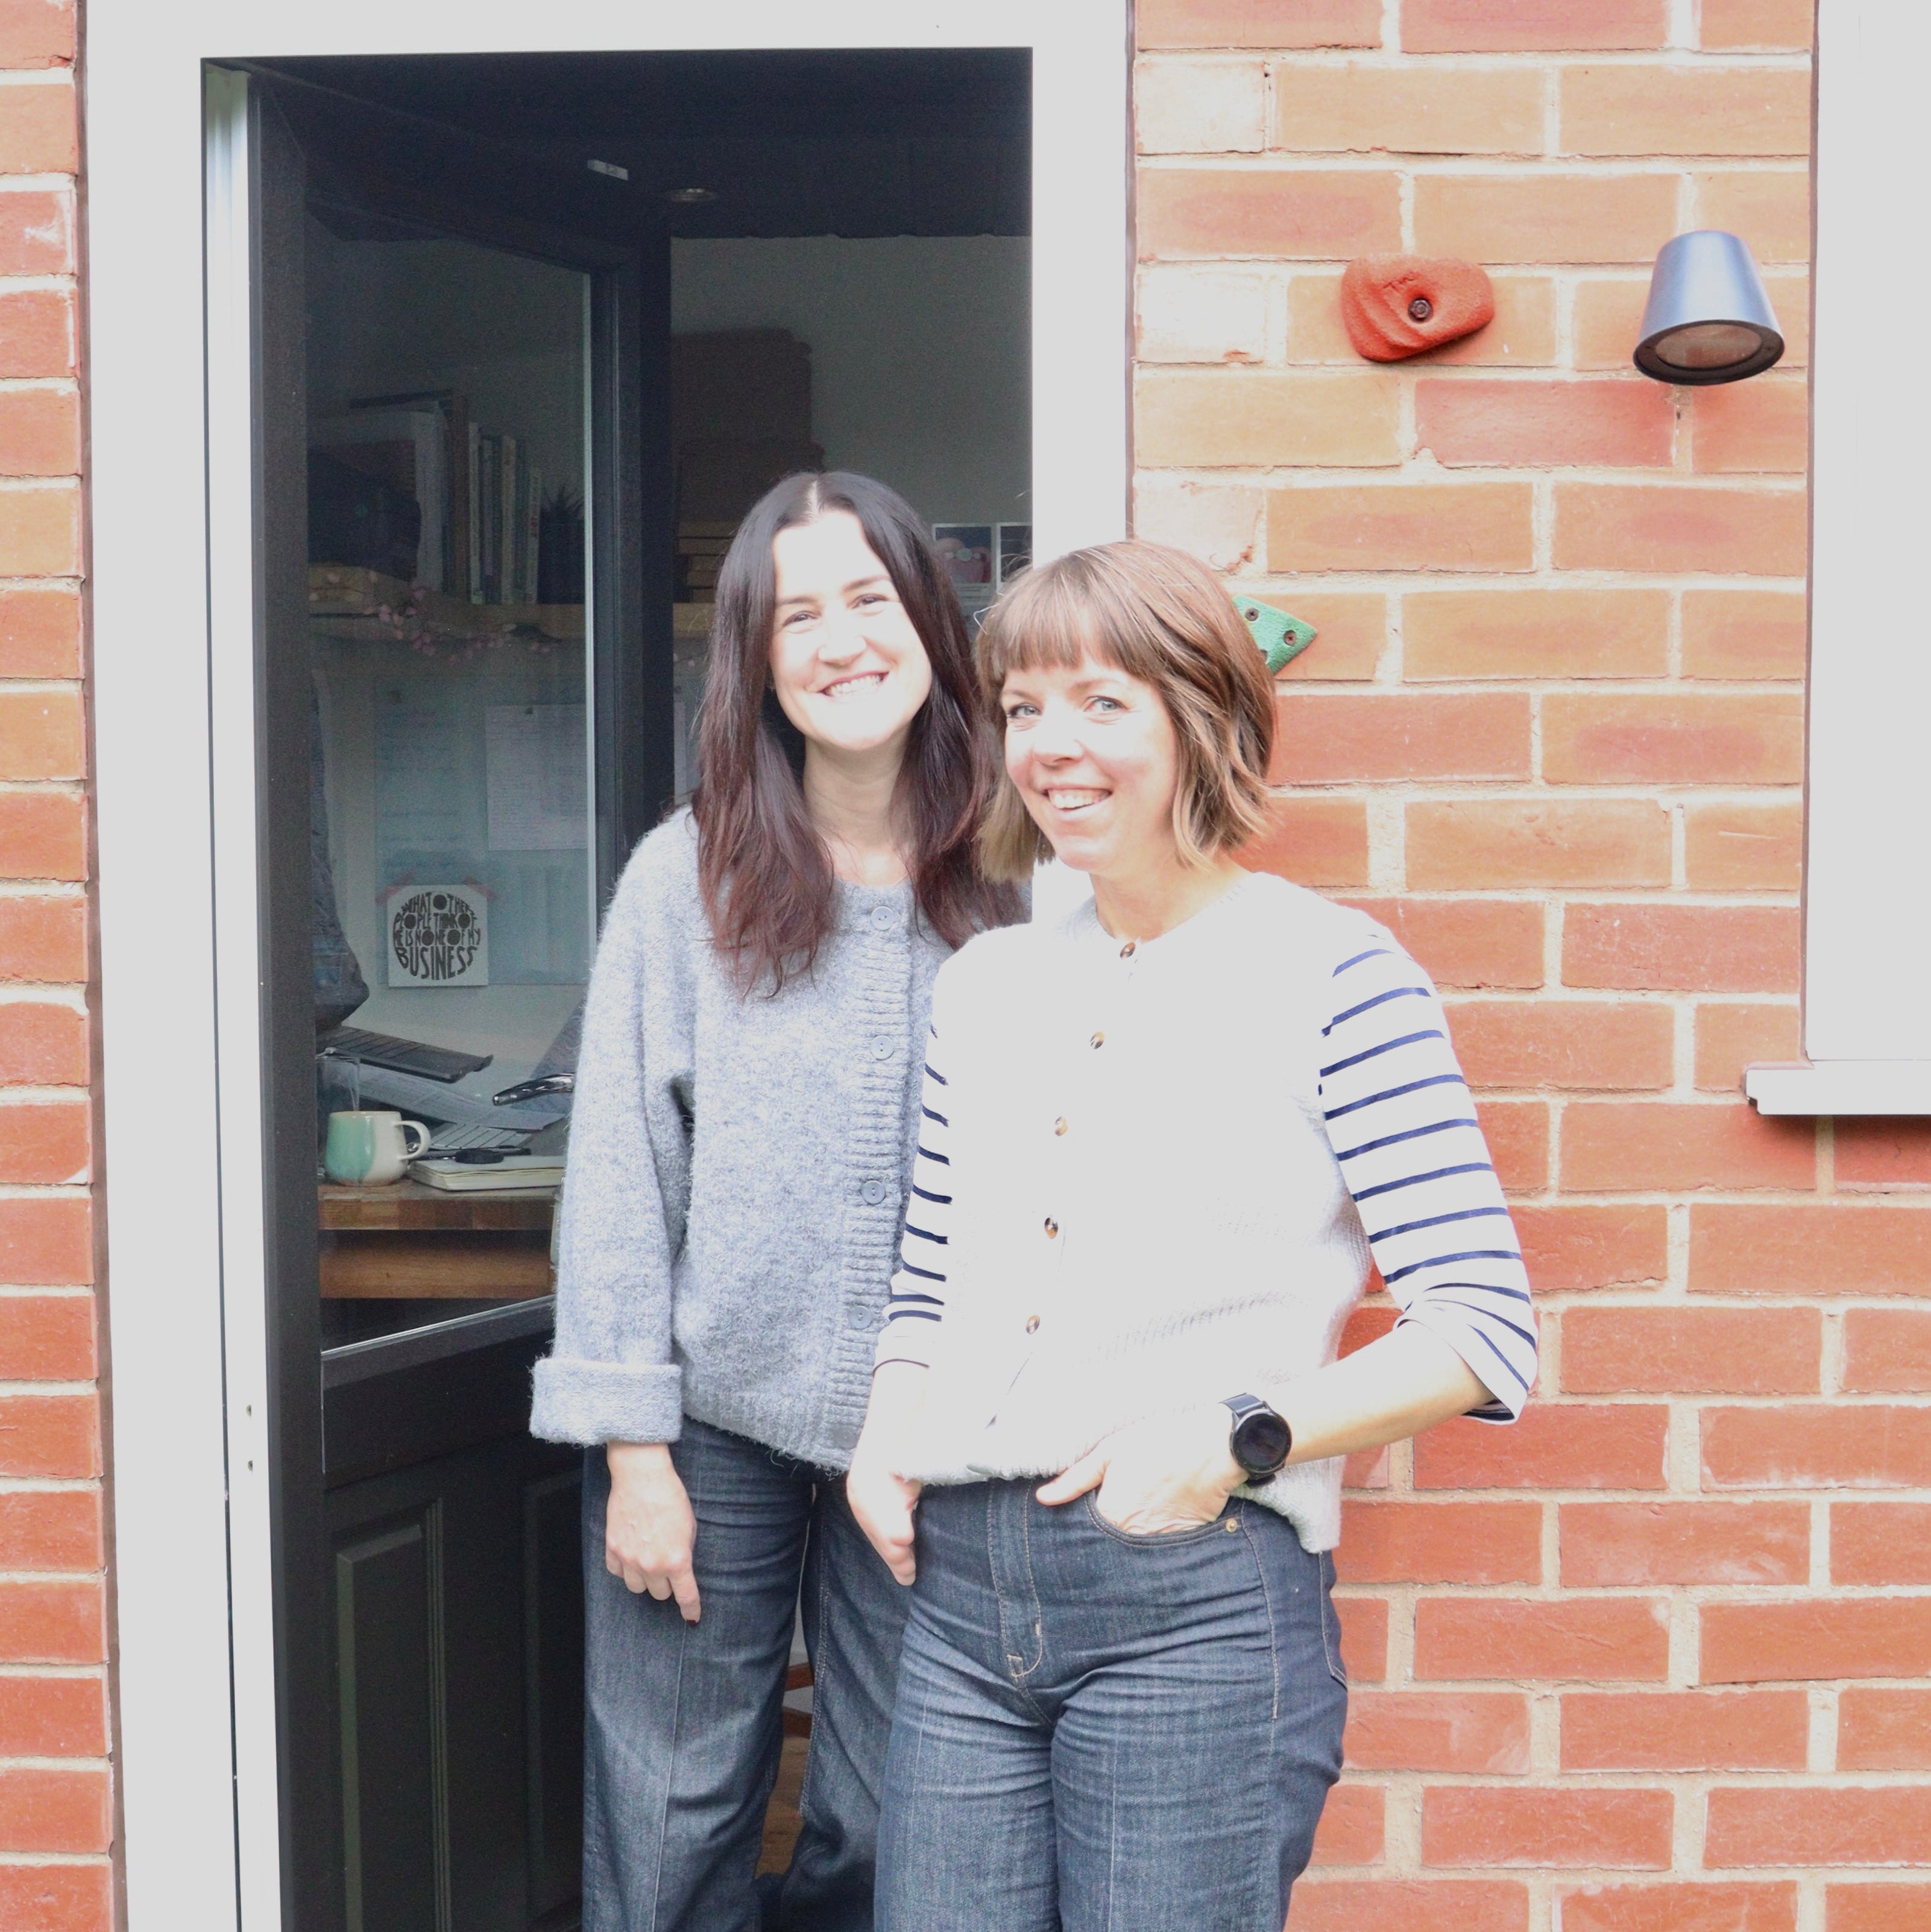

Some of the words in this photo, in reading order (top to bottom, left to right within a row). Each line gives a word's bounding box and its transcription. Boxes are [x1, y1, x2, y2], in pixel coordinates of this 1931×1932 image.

[401, 892, 432, 914] WHAT
[433, 894, 473, 914] OTHER
[393, 912, 432, 930] PEOPLE
[458, 909, 477, 930] OF
[393, 929, 404, 947] ME
[406, 930, 414, 946] IS
[415, 929, 446, 947] NONE
[447, 929, 465, 946] OF
[468, 928, 480, 946] MY
[395, 945, 477, 980] BUSINESS
